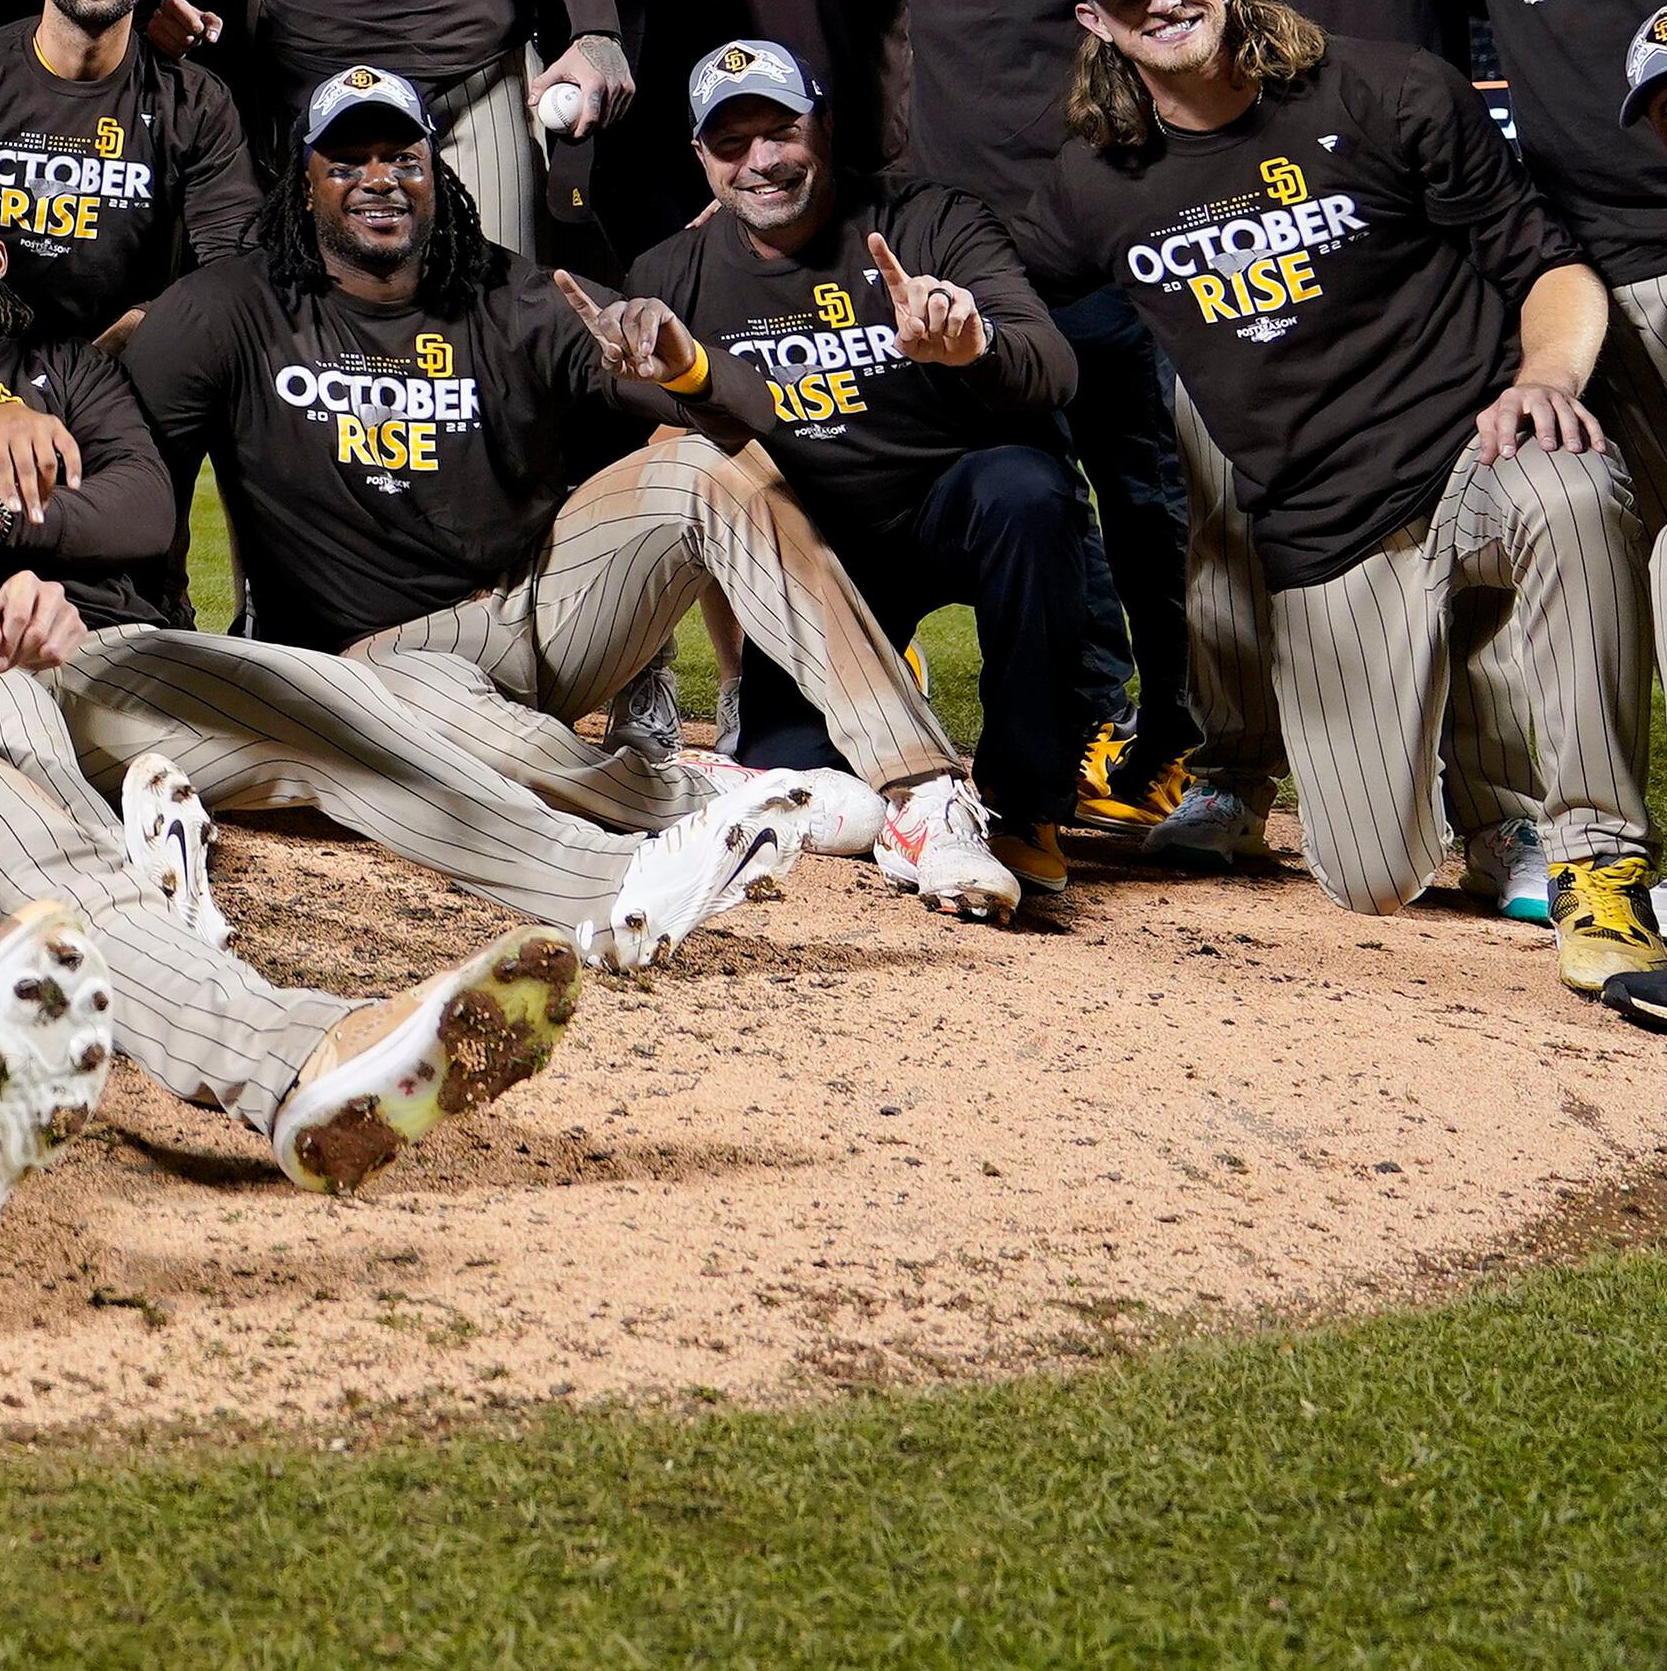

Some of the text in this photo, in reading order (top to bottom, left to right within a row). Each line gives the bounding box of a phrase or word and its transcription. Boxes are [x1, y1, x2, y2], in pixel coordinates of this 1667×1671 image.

[95, 116, 125, 160] SD
[108, 198, 128, 209] 22
[1258, 157, 1310, 206] SD
[1127, 192, 1368, 285] OCTOBER
[1318, 239, 1342, 255] 22
[812, 282, 859, 328] SD
[1162, 279, 1184, 294] 20
[1186, 251, 1324, 325] RISE
[415, 333, 455, 379] SD
[863, 364, 886, 378] 22
[275, 363, 480, 421] OCTOBER
[765, 370, 868, 424] RISE
[307, 410, 329, 421] 20
[445, 421, 467, 432] 22
[336, 420, 440, 471] RISE
